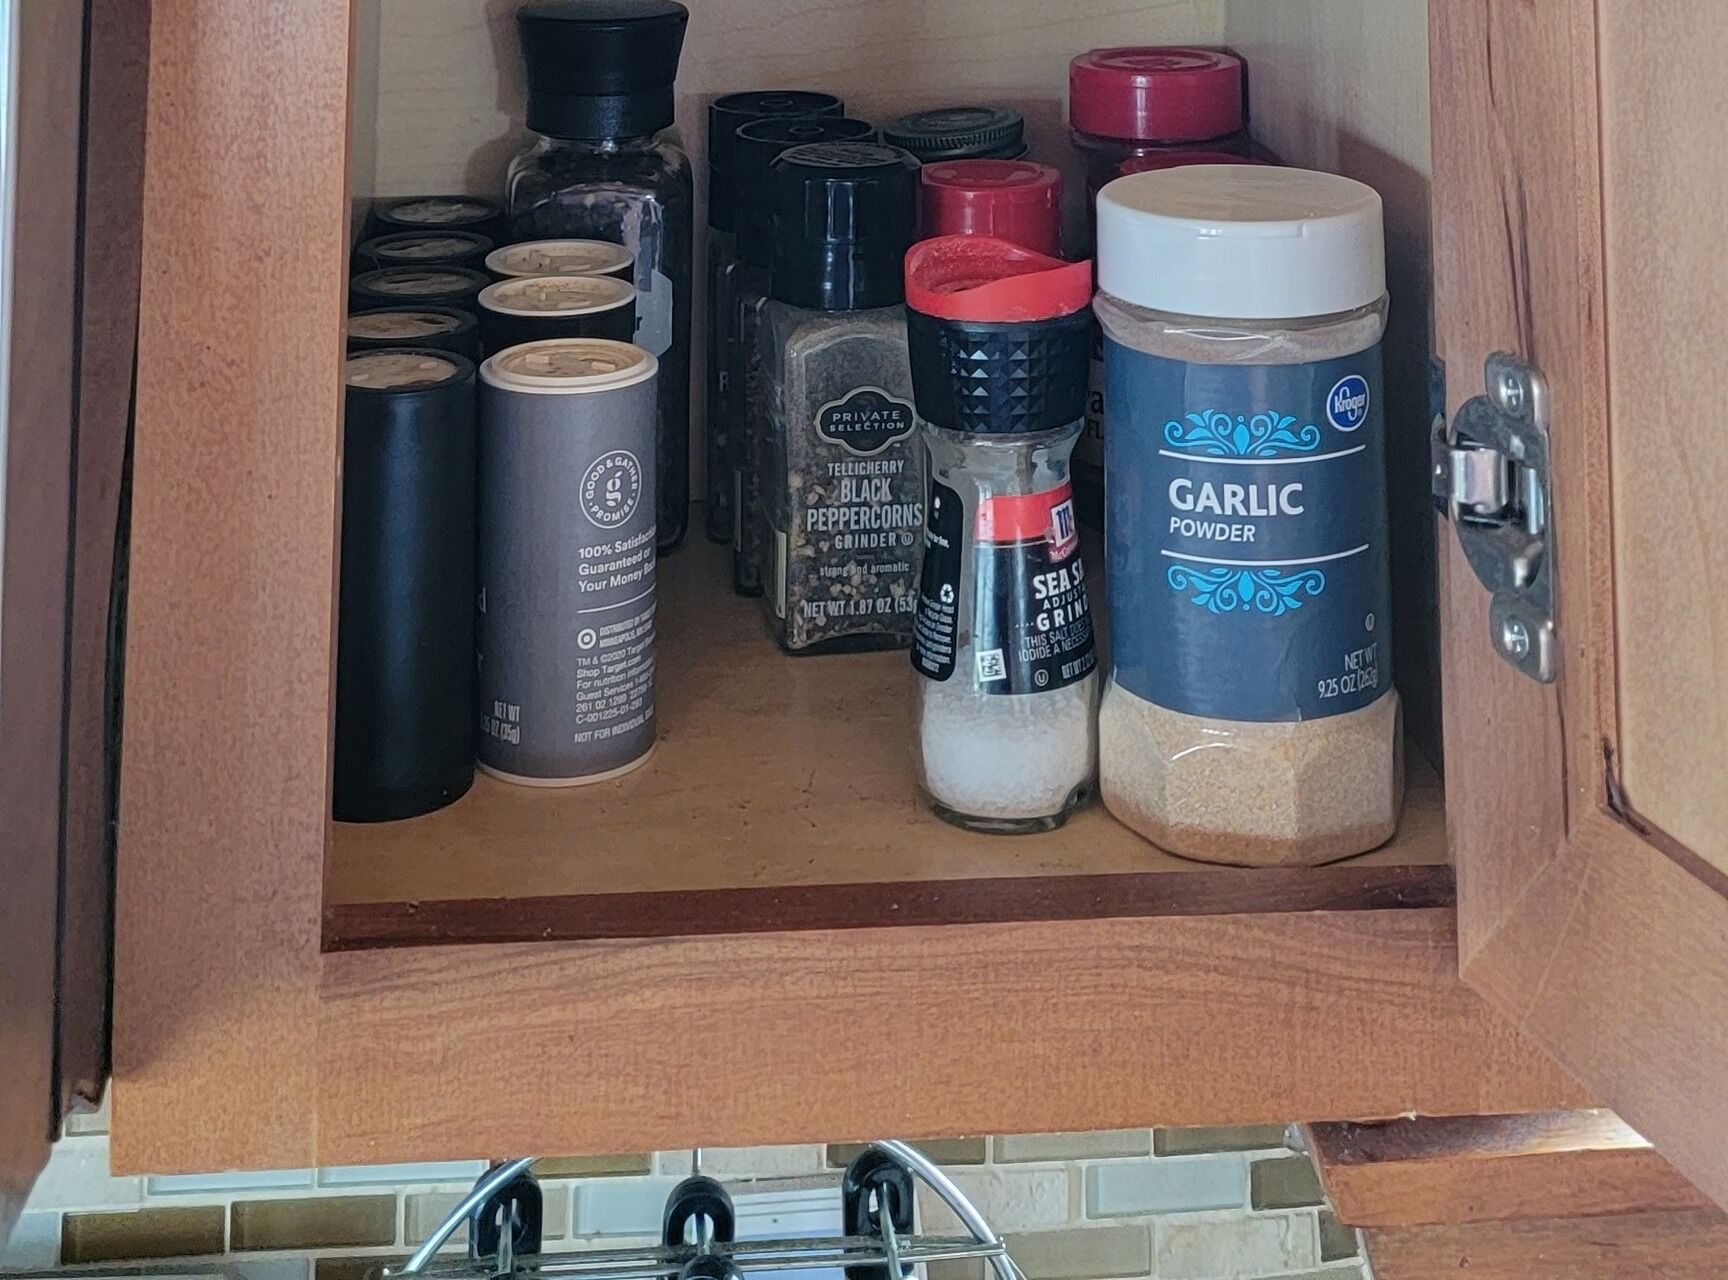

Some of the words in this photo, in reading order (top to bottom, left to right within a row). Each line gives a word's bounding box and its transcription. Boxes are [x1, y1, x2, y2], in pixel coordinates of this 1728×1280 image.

[1335, 387, 1366, 421] Kroger
[829, 422, 904, 432] SELECTION
[832, 411, 901, 422] PRIVATE
[586, 465, 605, 499] GOOD
[606, 459, 613, 468] &
[615, 457, 638, 490] GATHER
[828, 459, 905, 476] TELLICHERRY
[840, 478, 892, 504] BLACK
[1168, 478, 1304, 517] GARLIC
[590, 499, 634, 522] PROMISE
[807, 503, 923, 532] PEPPERCORNS
[1169, 517, 1256, 542] POWDER
[578, 543, 612, 559] 100%
[835, 531, 897, 550] GRINDER
[579, 549, 642, 575] Guaranteed
[644, 547, 651, 558] or
[819, 564, 848, 576] strong
[870, 561, 910, 574] aromatic
[578, 580, 607, 592] Your
[610, 569, 643, 587] Money
[1033, 567, 1071, 600] SEA
[803, 601, 825, 618] NET
[829, 600, 847, 616] WT
[877, 597, 892, 614] OZ
[1024, 633, 1048, 649] THIS
[1049, 625, 1069, 643] SALT
[576, 657, 591, 667] TM
[1018, 645, 1052, 662] IODIDE
[1053, 642, 1061, 655] A
[1344, 649, 1364, 671] NET
[1363, 642, 1377, 664] WT
[576, 668, 600, 679] Shop
[601, 654, 642, 674] Target.com
[576, 680, 592, 690] For
[594, 673, 626, 687] nutrition
[576, 690, 601, 701] Guest
[604, 681, 634, 697] Services
[1340, 673, 1357, 694] OZ
[508, 703, 520, 723] WT
[595, 700, 606, 710] 02
[575, 730, 592, 743] NOT
[594, 727, 611, 740] FOR
